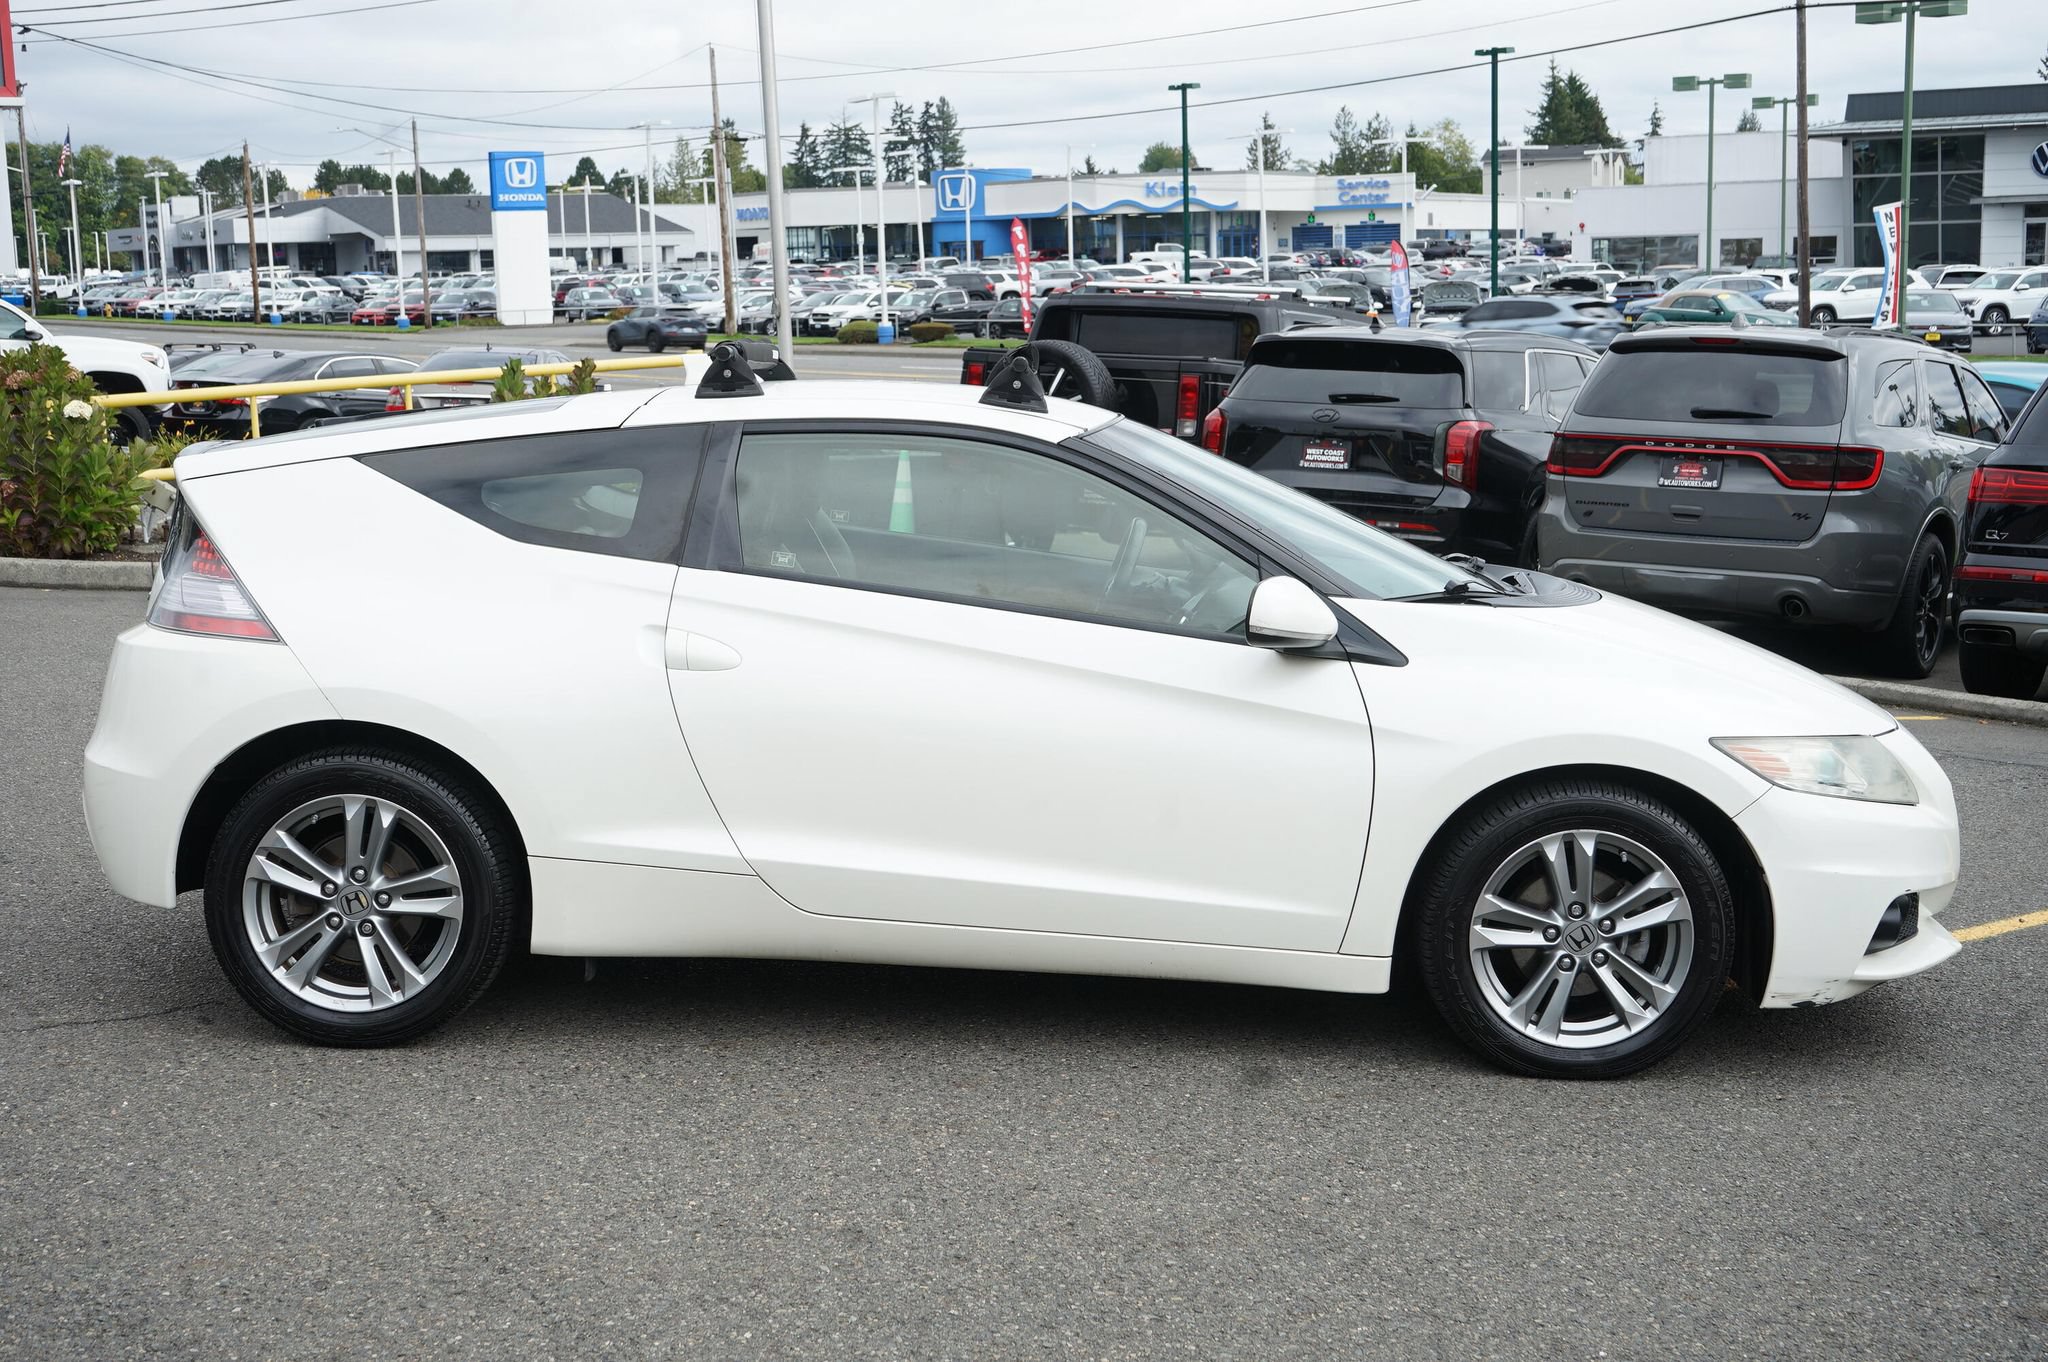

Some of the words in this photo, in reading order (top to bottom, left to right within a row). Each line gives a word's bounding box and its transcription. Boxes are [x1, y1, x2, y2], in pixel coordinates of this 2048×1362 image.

[1337, 178, 1389, 190] Service
[498, 193, 545, 202] HONDA
[1338, 191, 1389, 202] Center
[1645, 441, 1736, 450] DODGE
[1305, 454, 1345, 463] AUTOWORKS
[1663, 479, 1712, 488] WCAUTOWORKS.COM
[1575, 499, 1629, 508] DURANGO
[1985, 529, 2009, 540] Q7
